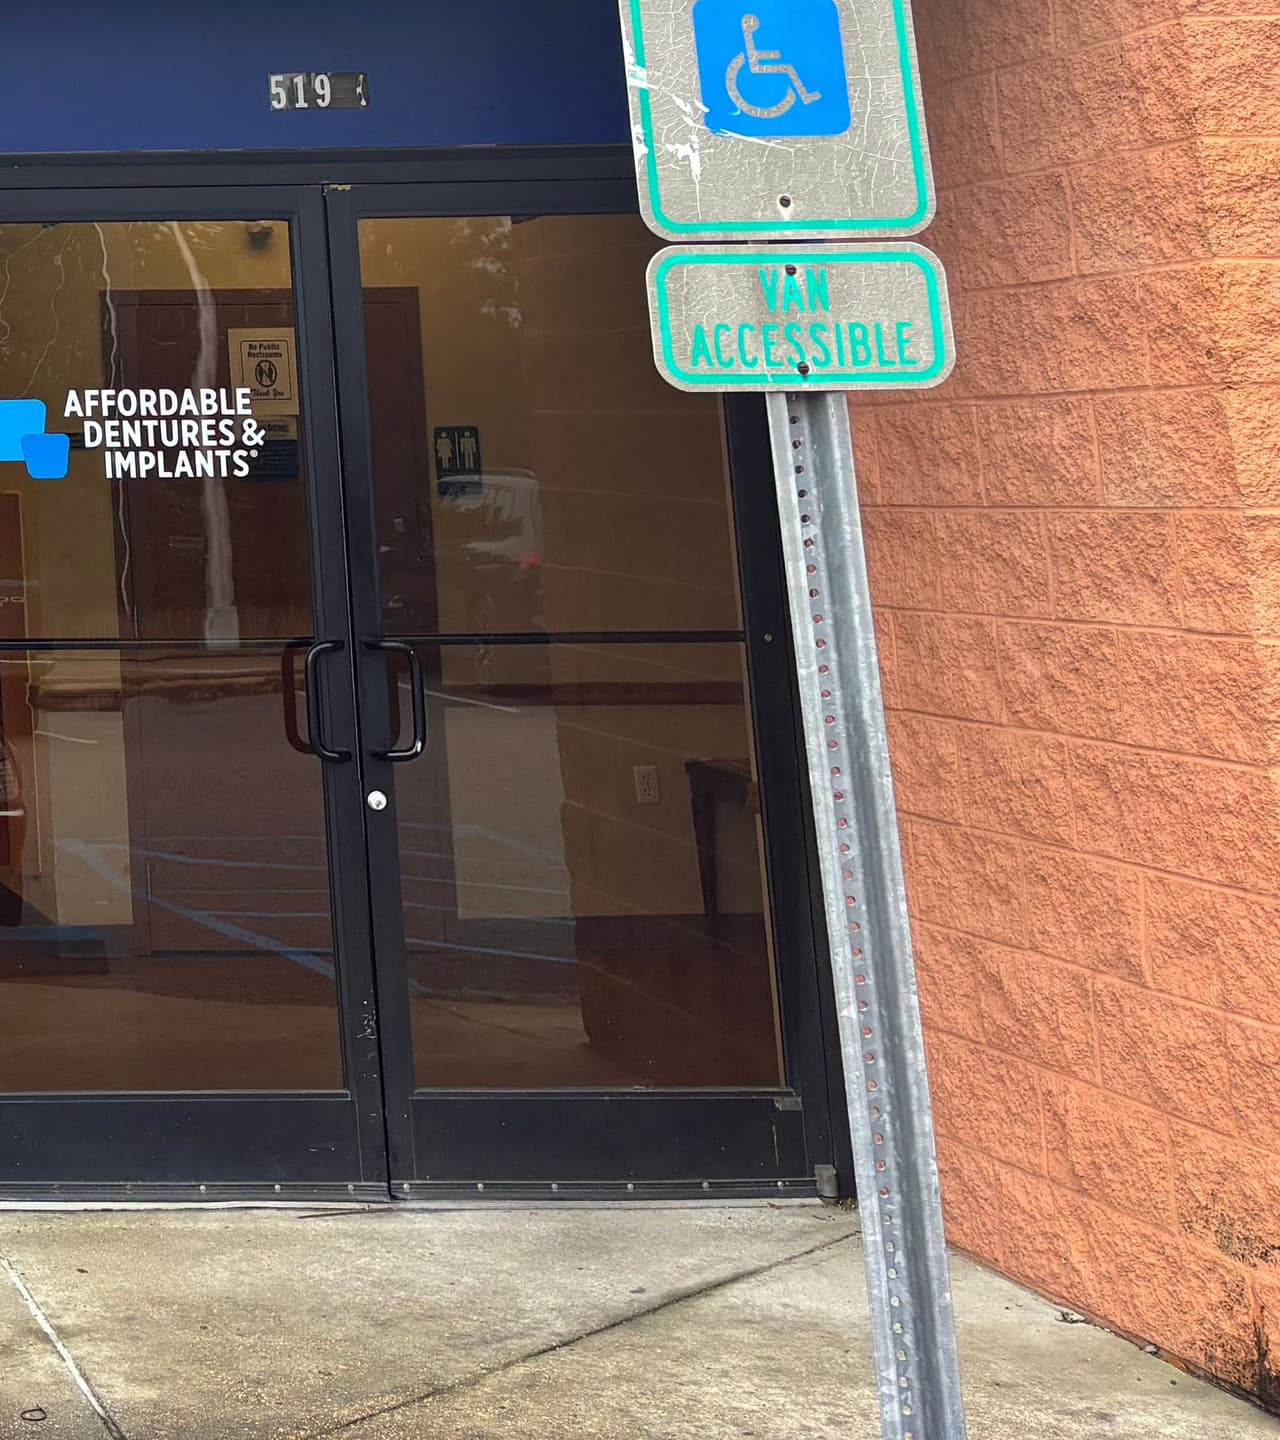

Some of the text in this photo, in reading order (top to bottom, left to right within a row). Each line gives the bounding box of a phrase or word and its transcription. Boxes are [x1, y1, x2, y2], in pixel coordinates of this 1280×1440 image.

[758, 267, 831, 313] VAN
[690, 321, 919, 370] ACCESSIBLE
[63, 387, 253, 418] AFFORDABLE
[83, 417, 267, 449] DENTURES &
